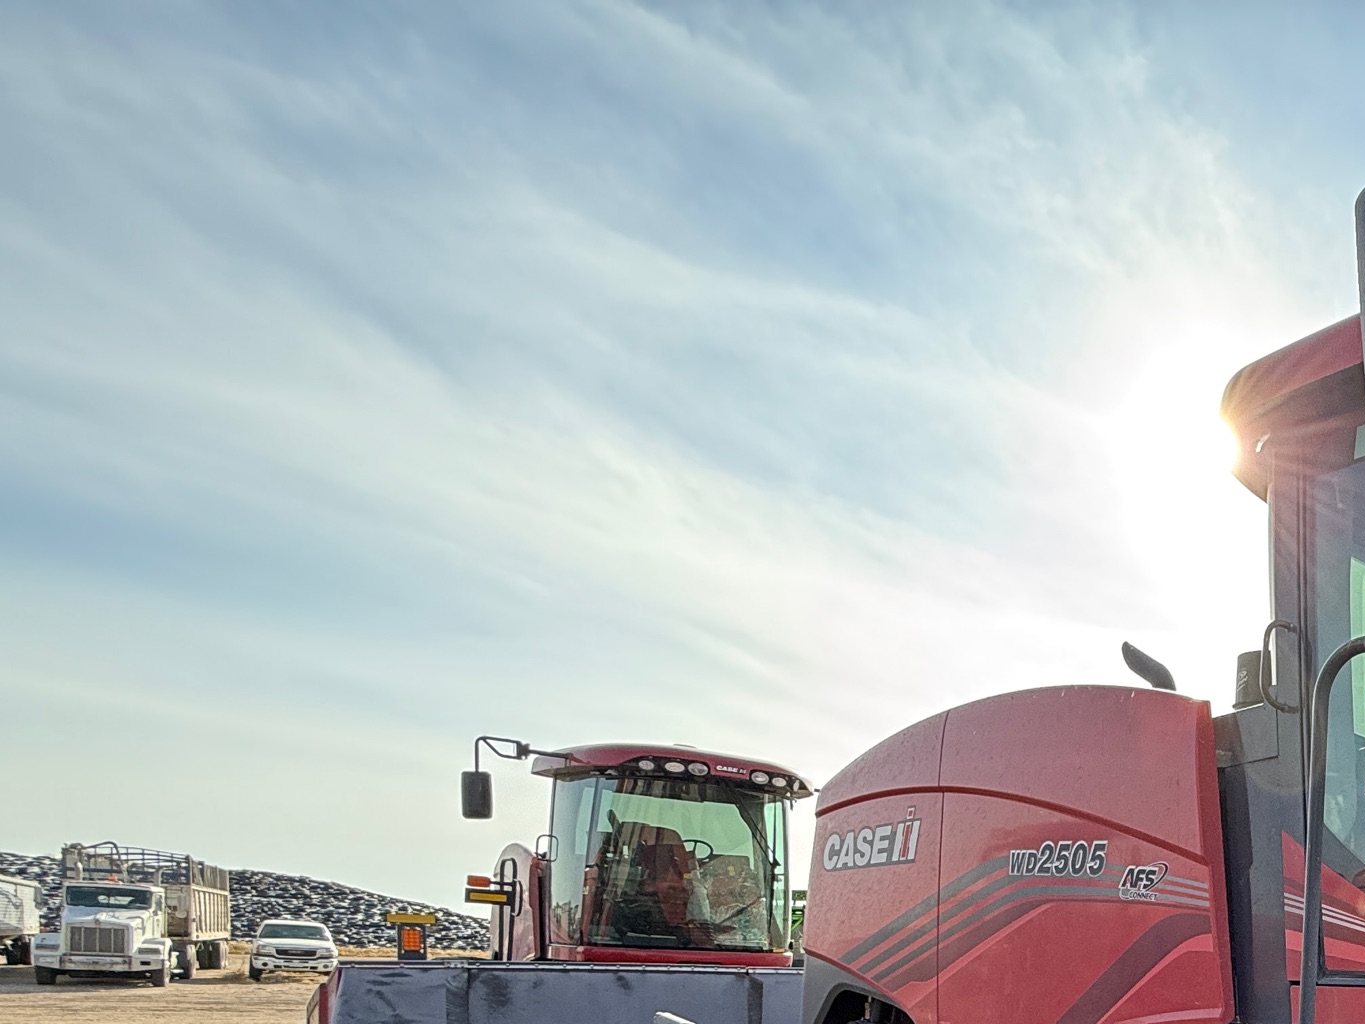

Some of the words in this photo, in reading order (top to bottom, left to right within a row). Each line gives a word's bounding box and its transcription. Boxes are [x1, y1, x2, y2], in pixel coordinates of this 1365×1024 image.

[823, 825, 892, 870] CASE
[1009, 840, 1109, 877] WD2505
[1119, 865, 1160, 890] AFS
[1128, 889, 1158, 901] CONNECT
